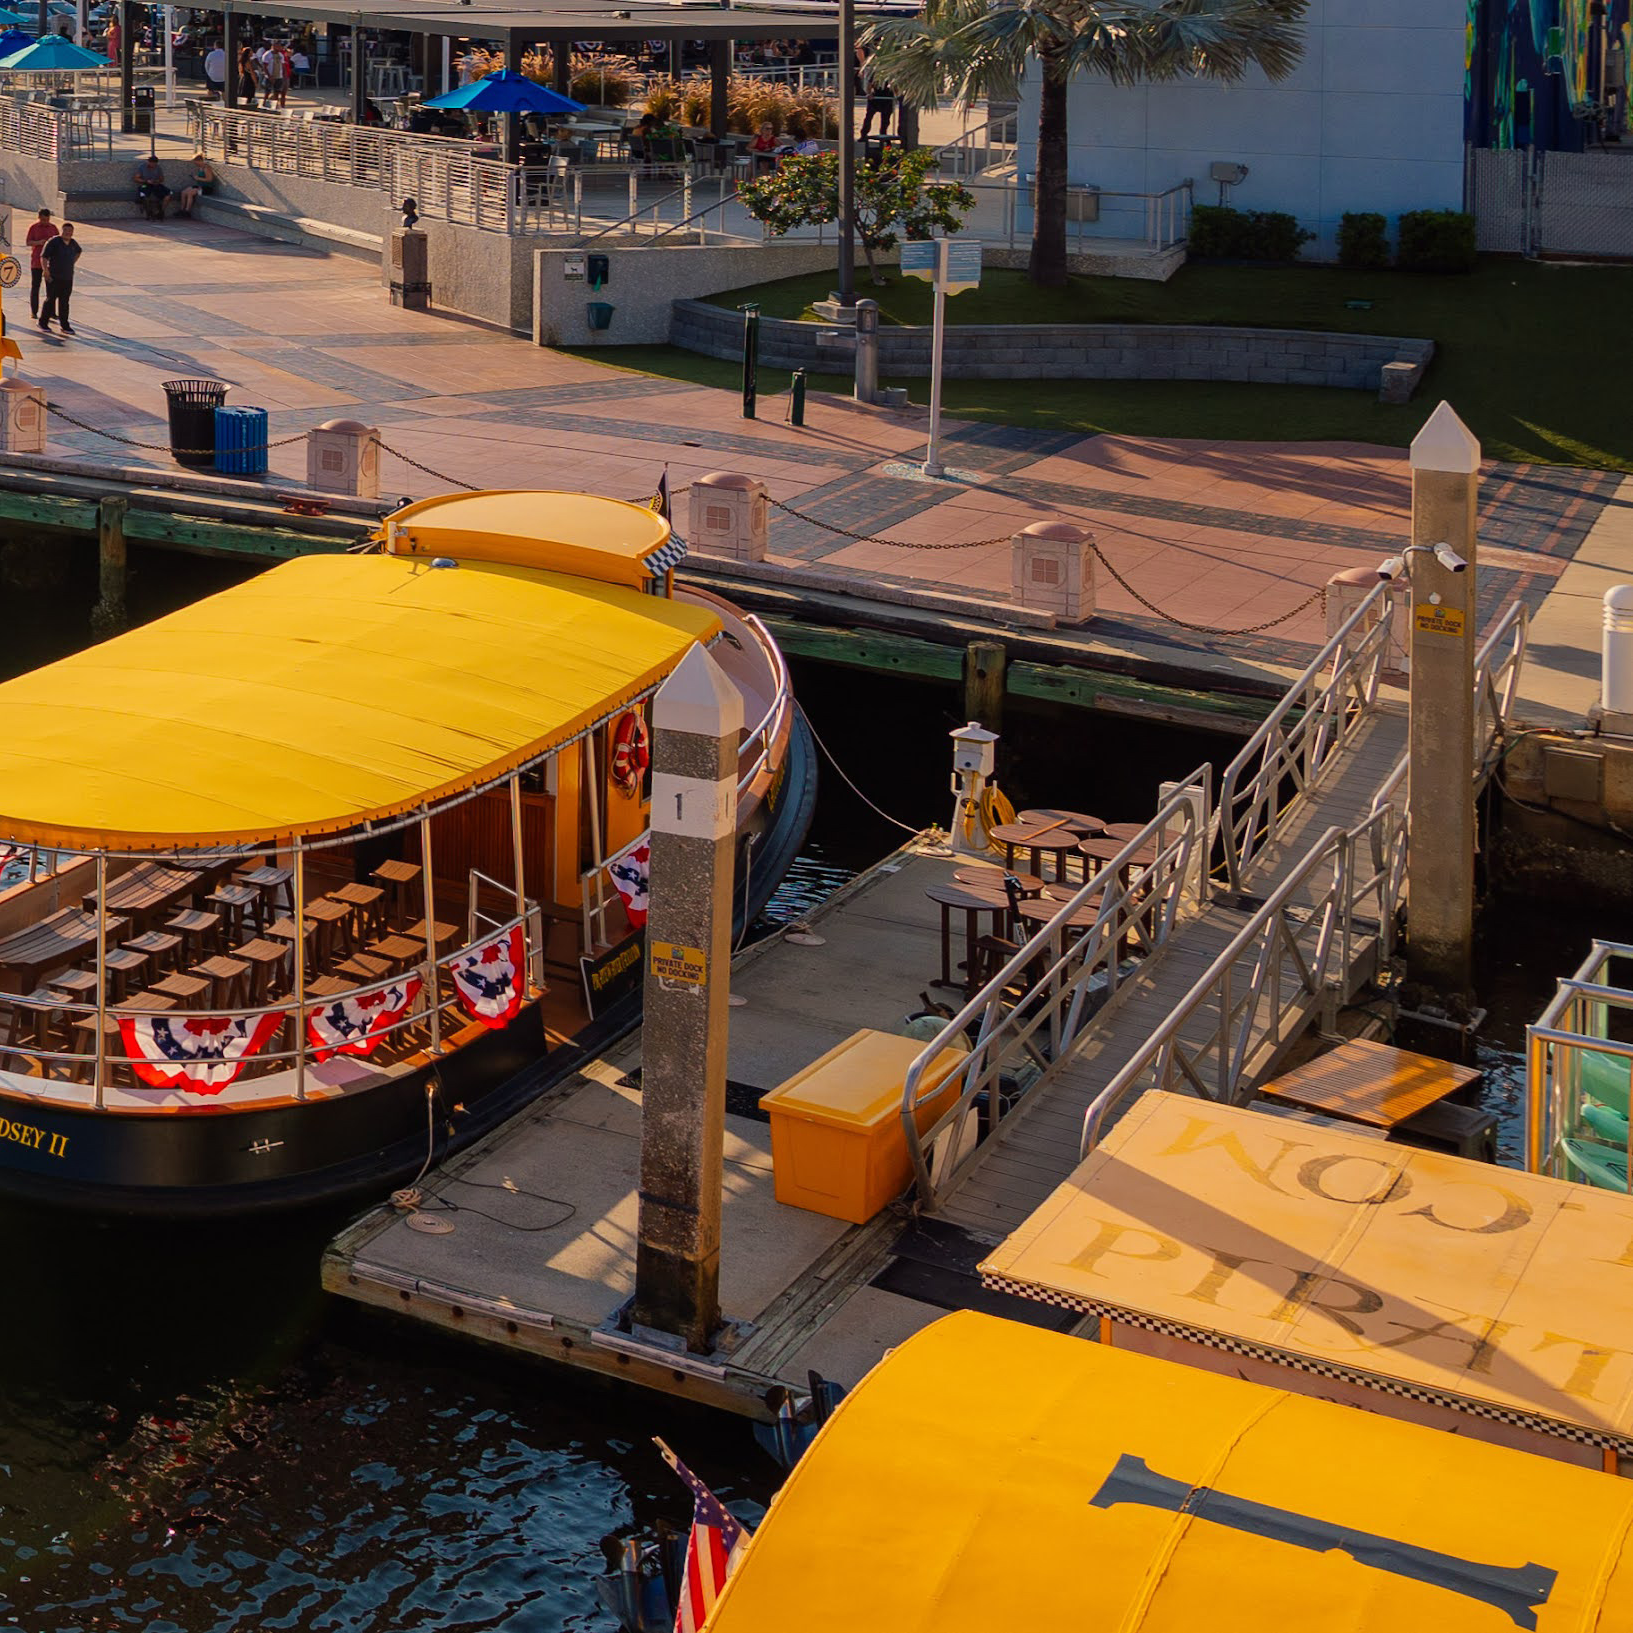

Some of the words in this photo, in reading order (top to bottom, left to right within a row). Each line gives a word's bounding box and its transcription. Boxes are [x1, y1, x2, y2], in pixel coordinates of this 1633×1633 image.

[3, 266, 13, 280] 7
[674, 793, 683, 820] 1
[653, 956, 682, 969] PRIVATE
[684, 962, 704, 973] DOCK
[657, 965, 666, 973] NO
[668, 968, 699, 980] DOCKING
[49, 1132, 70, 1158] II
